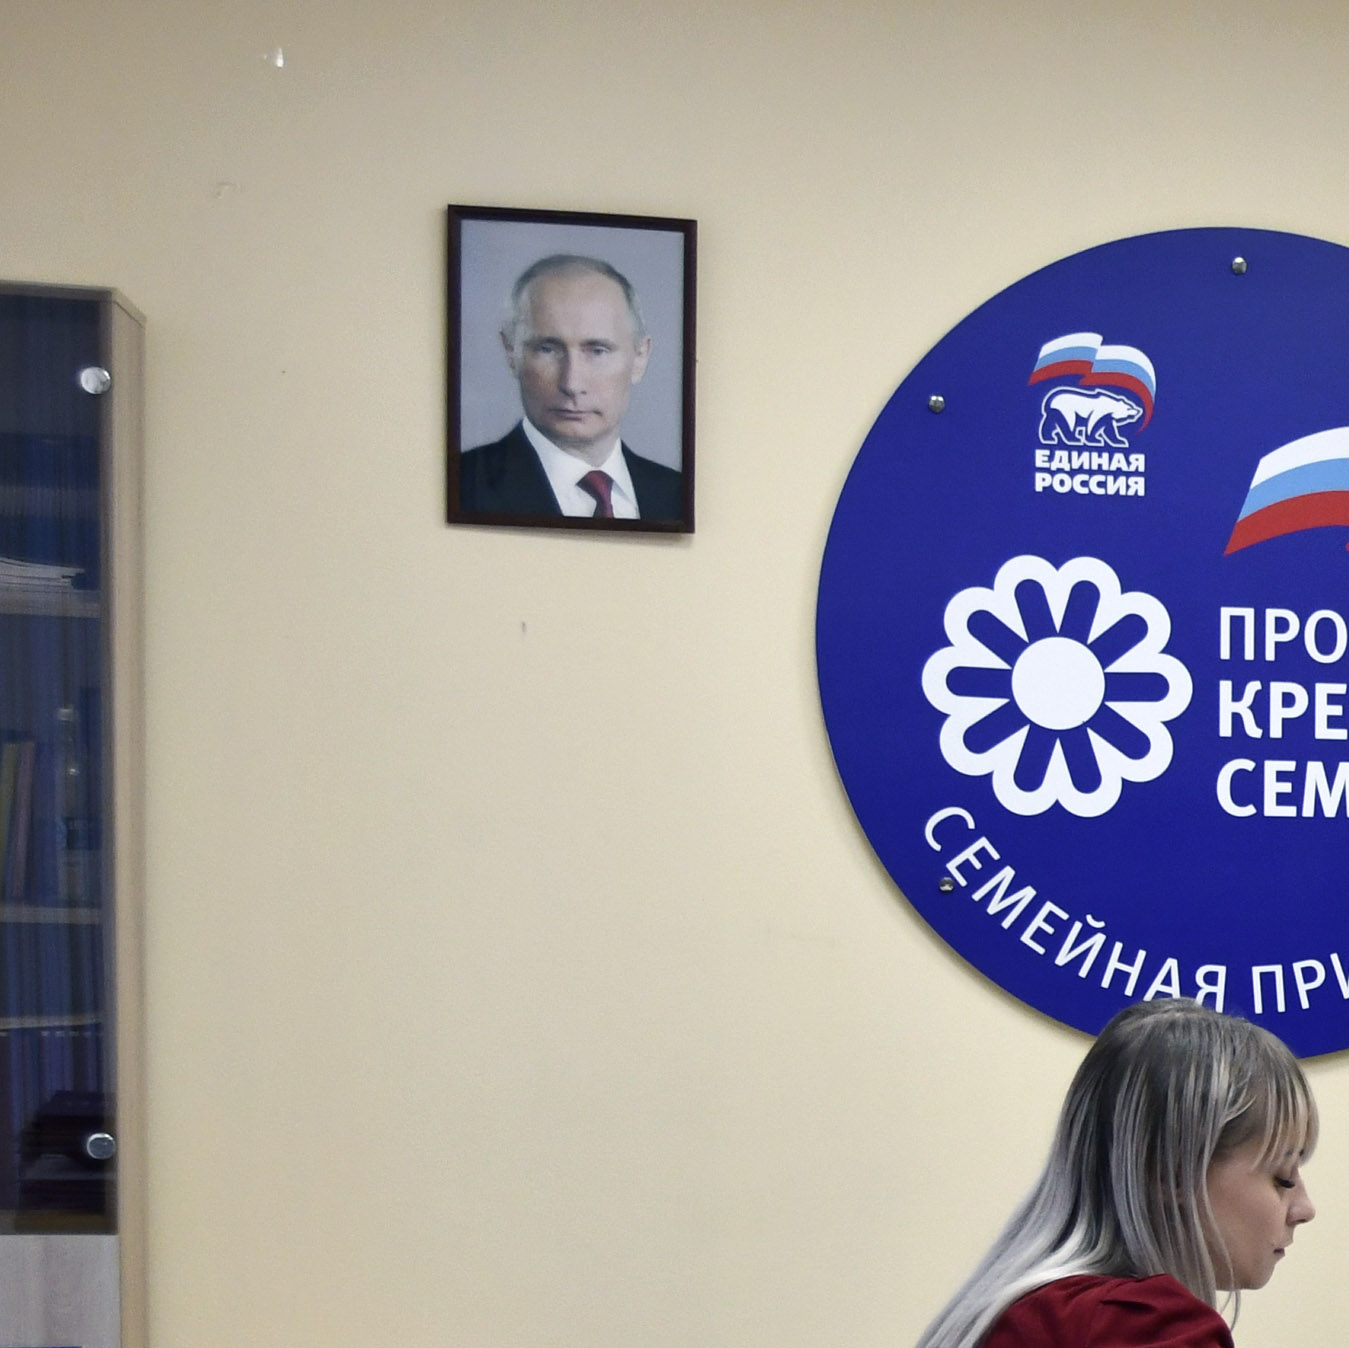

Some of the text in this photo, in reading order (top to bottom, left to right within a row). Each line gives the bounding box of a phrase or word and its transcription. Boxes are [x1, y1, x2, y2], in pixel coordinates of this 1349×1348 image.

[1035, 449, 1145, 473] ЕДИНАЯ
[1034, 471, 1145, 497] РОССИЯ
[924, 806, 1228, 1014] СЕМЕЙНАЯ
